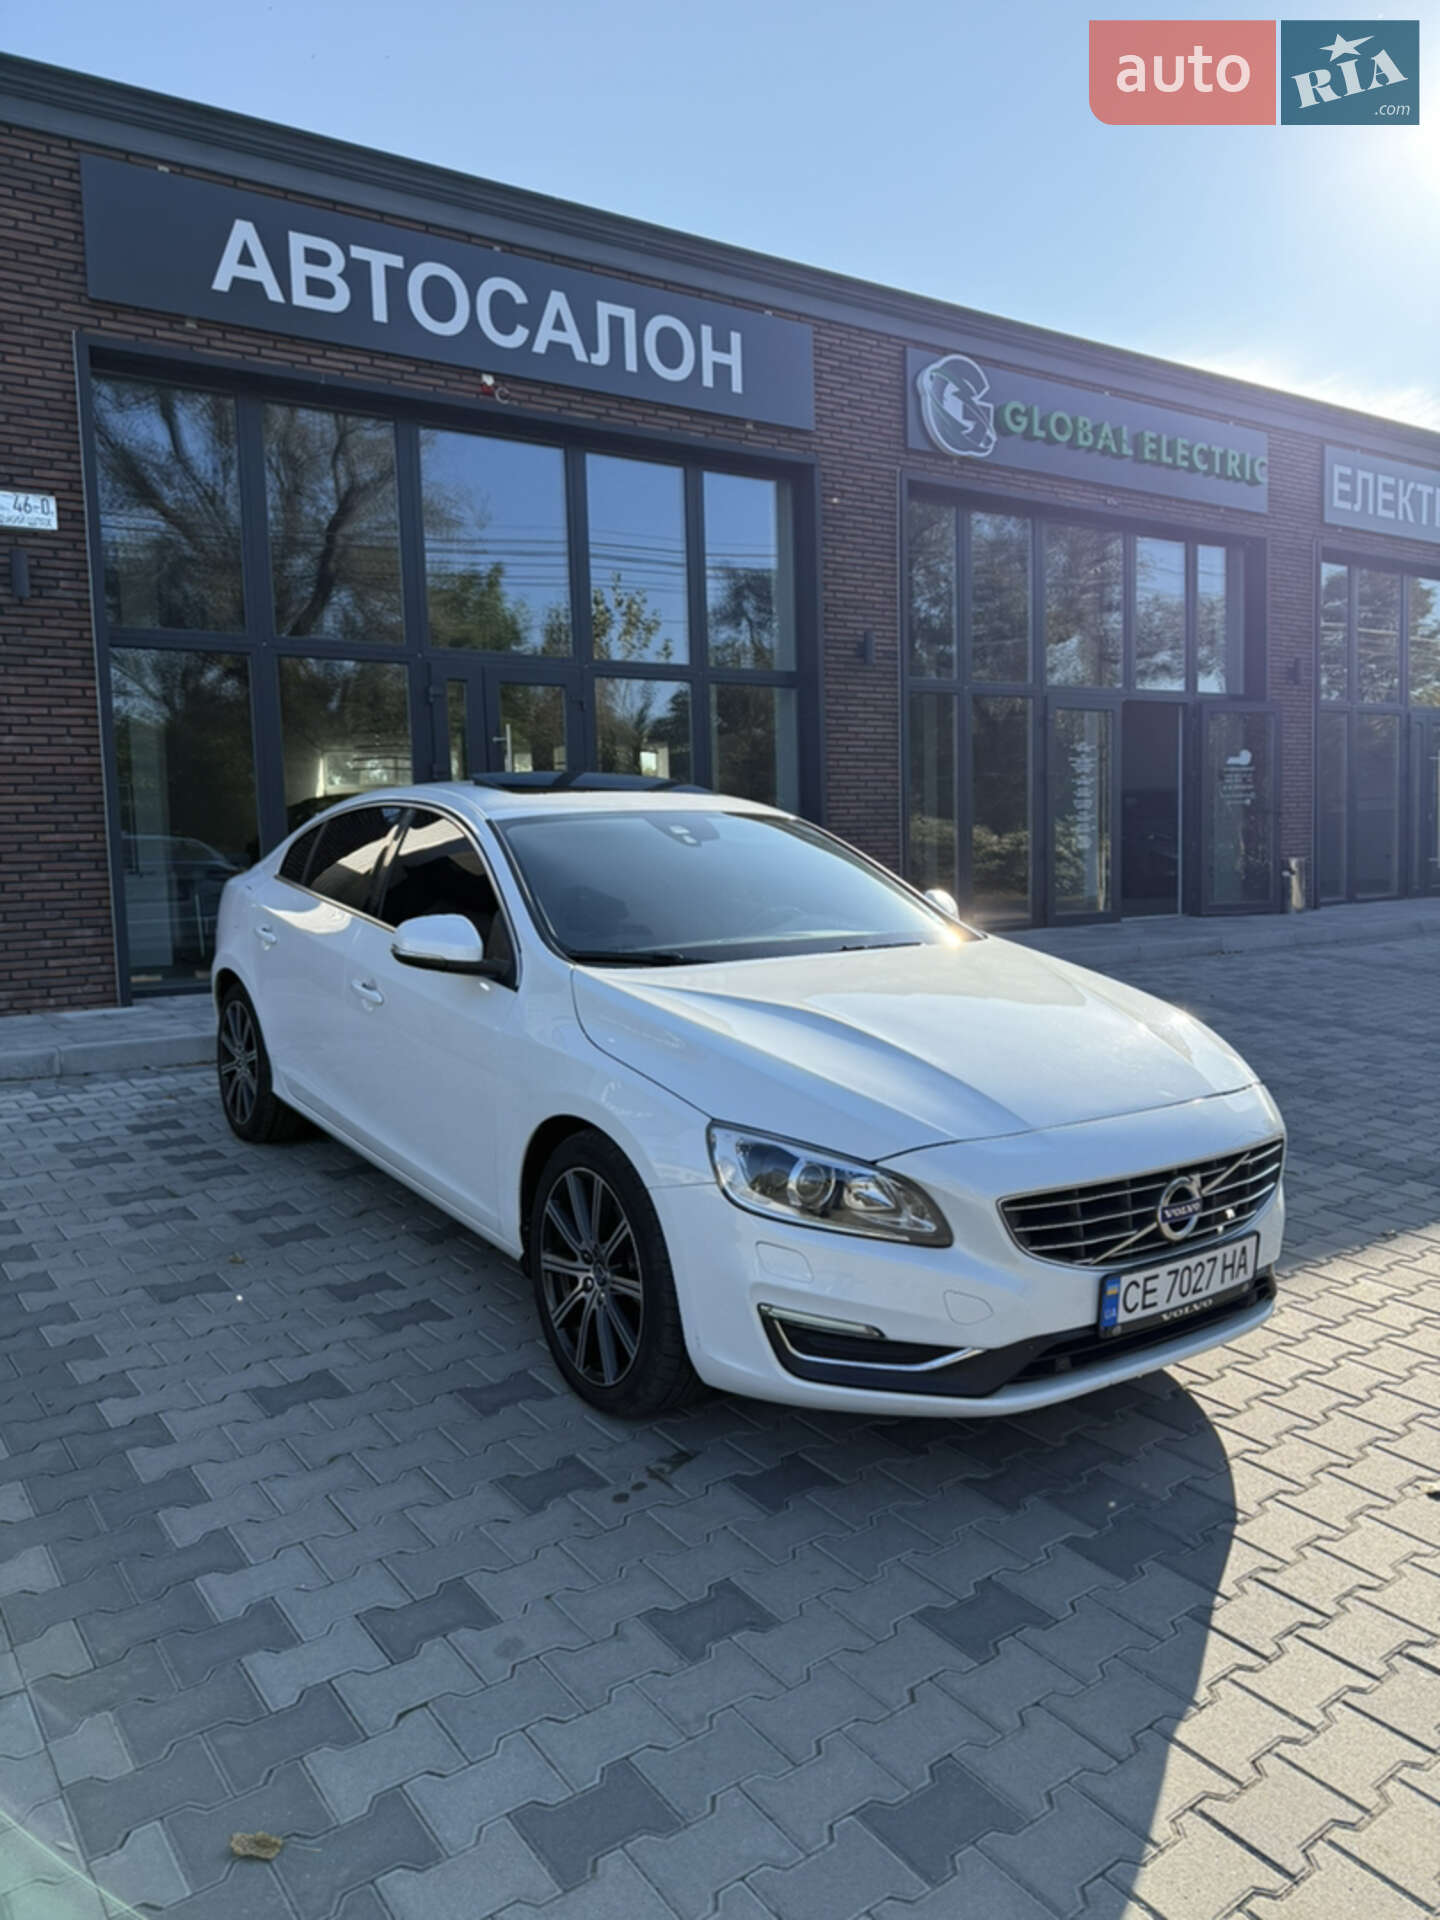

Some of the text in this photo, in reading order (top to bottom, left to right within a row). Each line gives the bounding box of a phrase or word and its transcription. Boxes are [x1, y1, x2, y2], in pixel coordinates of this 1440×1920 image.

[211, 218, 743, 394] АВТОСАЛОН
[1002, 400, 1269, 485] GLOBAL ELECTRIC
[1333, 463, 1440, 528] ЕЛЕКТ
[1122, 1245, 1248, 1314] CE 7027 HA
[1161, 1298, 1214, 1321] VOLVO
